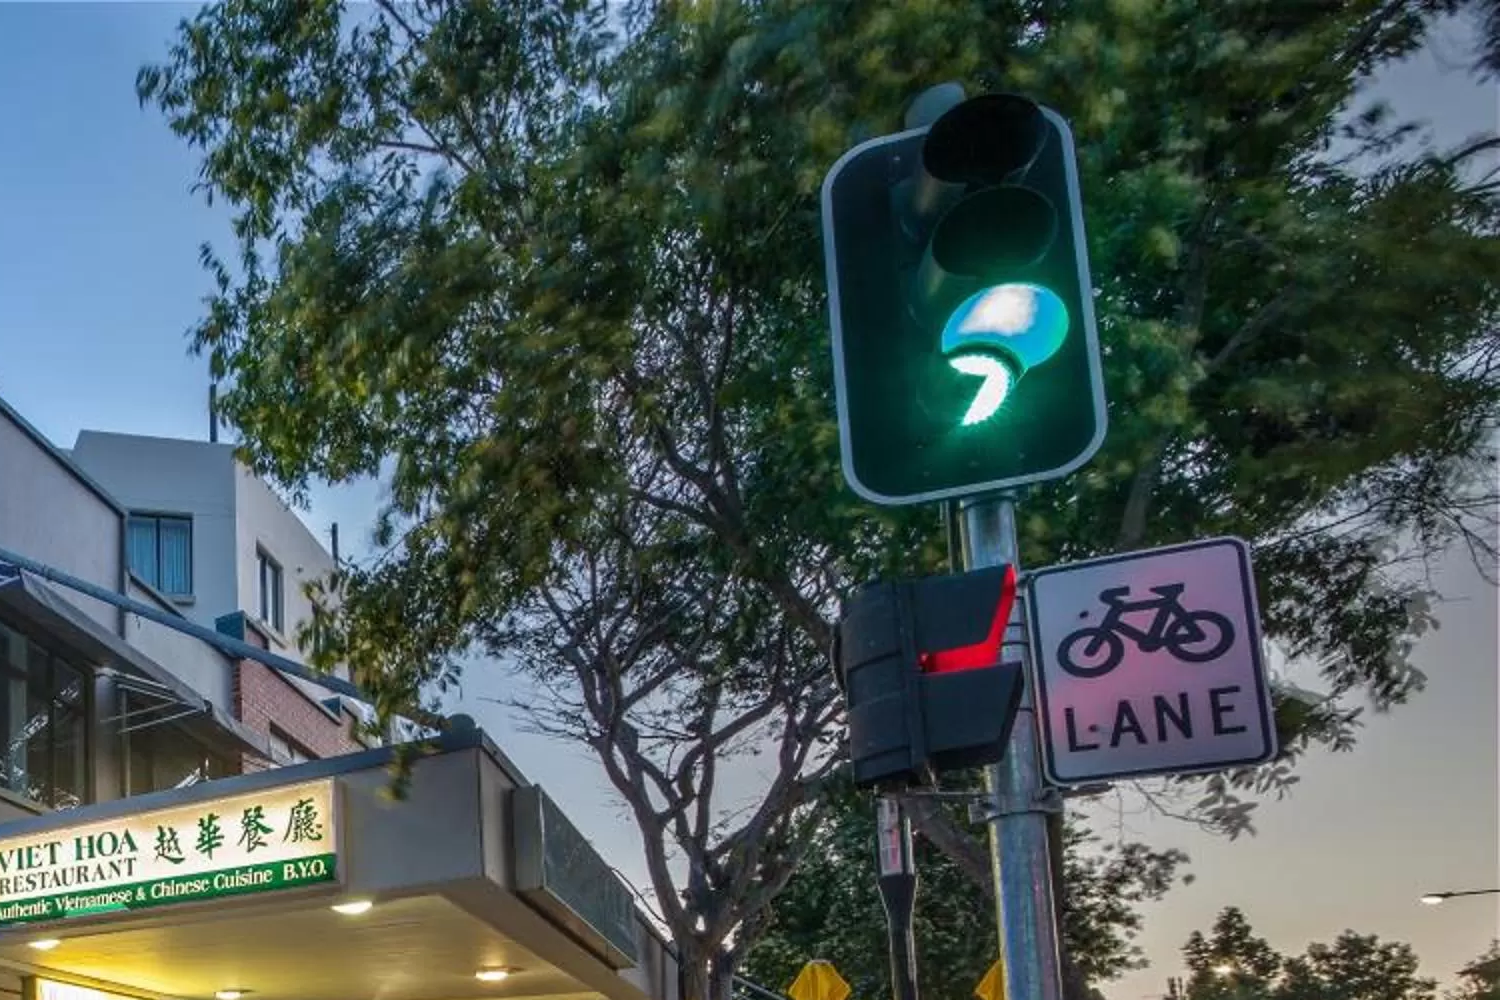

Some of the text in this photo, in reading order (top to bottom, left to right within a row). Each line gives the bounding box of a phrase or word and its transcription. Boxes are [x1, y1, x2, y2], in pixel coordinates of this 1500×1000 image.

[1064, 685, 1247, 753] LANE
[74, 828, 138, 861] HOA
[154, 797, 324, 865] 越華餐廳
[0, 857, 137, 896] RESTAURANT
[55, 889, 133, 911] Vietnamese
[136, 886, 146, 901] &
[151, 878, 211, 900] Chinese
[213, 867, 273, 890] Cuisine
[283, 858, 327, 881] B.Y.O.
